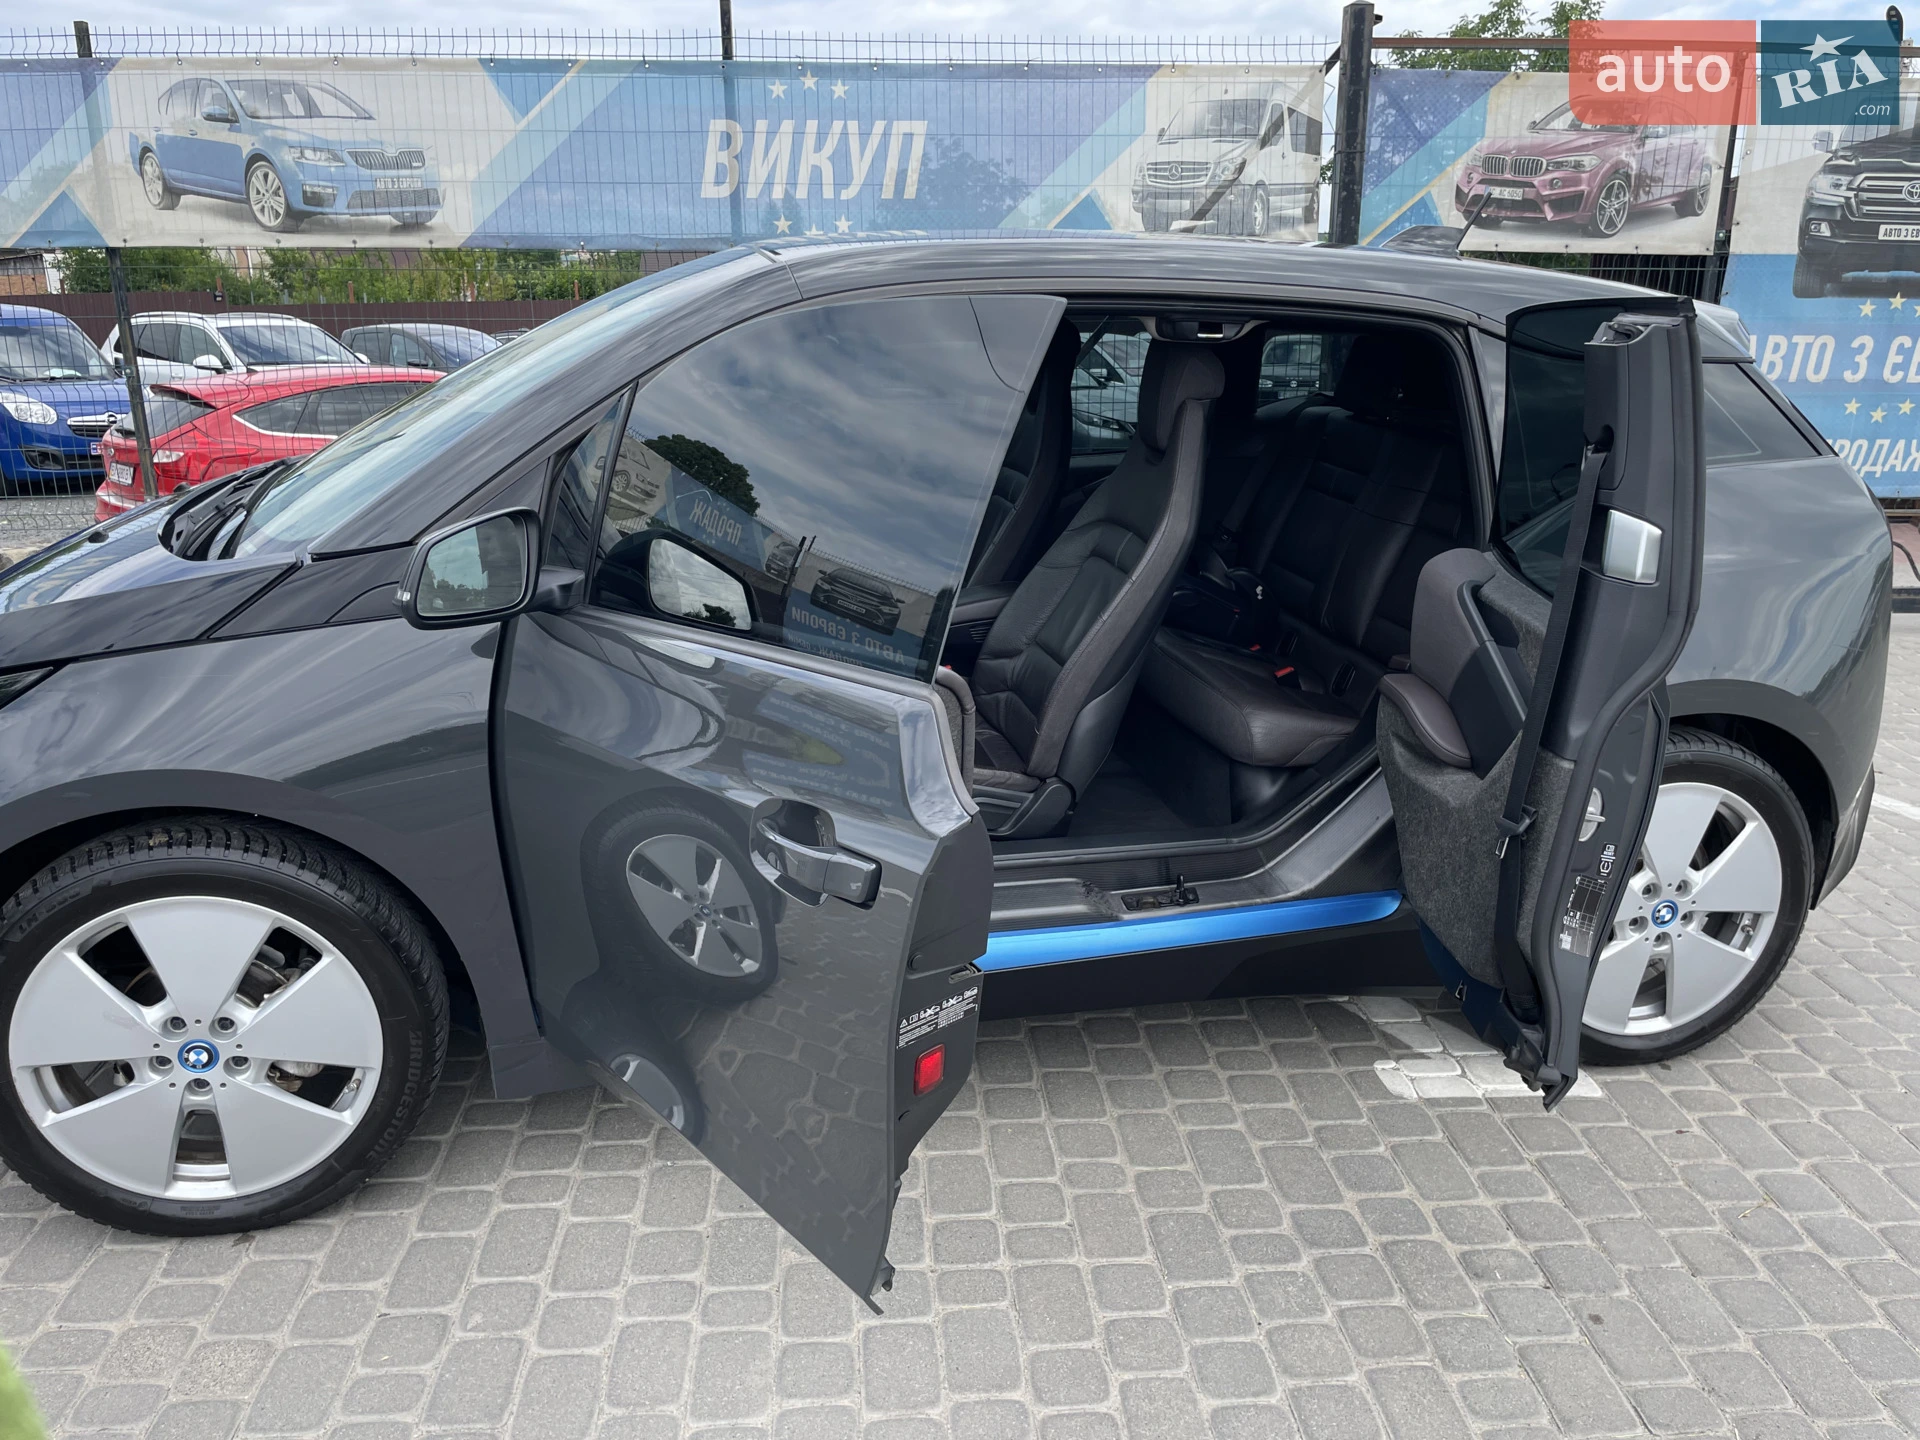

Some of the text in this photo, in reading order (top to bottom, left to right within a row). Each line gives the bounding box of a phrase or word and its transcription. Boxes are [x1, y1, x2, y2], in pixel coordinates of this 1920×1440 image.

[700, 119, 929, 200] ВИКУП
[1882, 227, 1902, 238] АВТО
[1843, 334, 1874, 384] З
[366, 1030, 423, 1160] BRIDGESTONE
